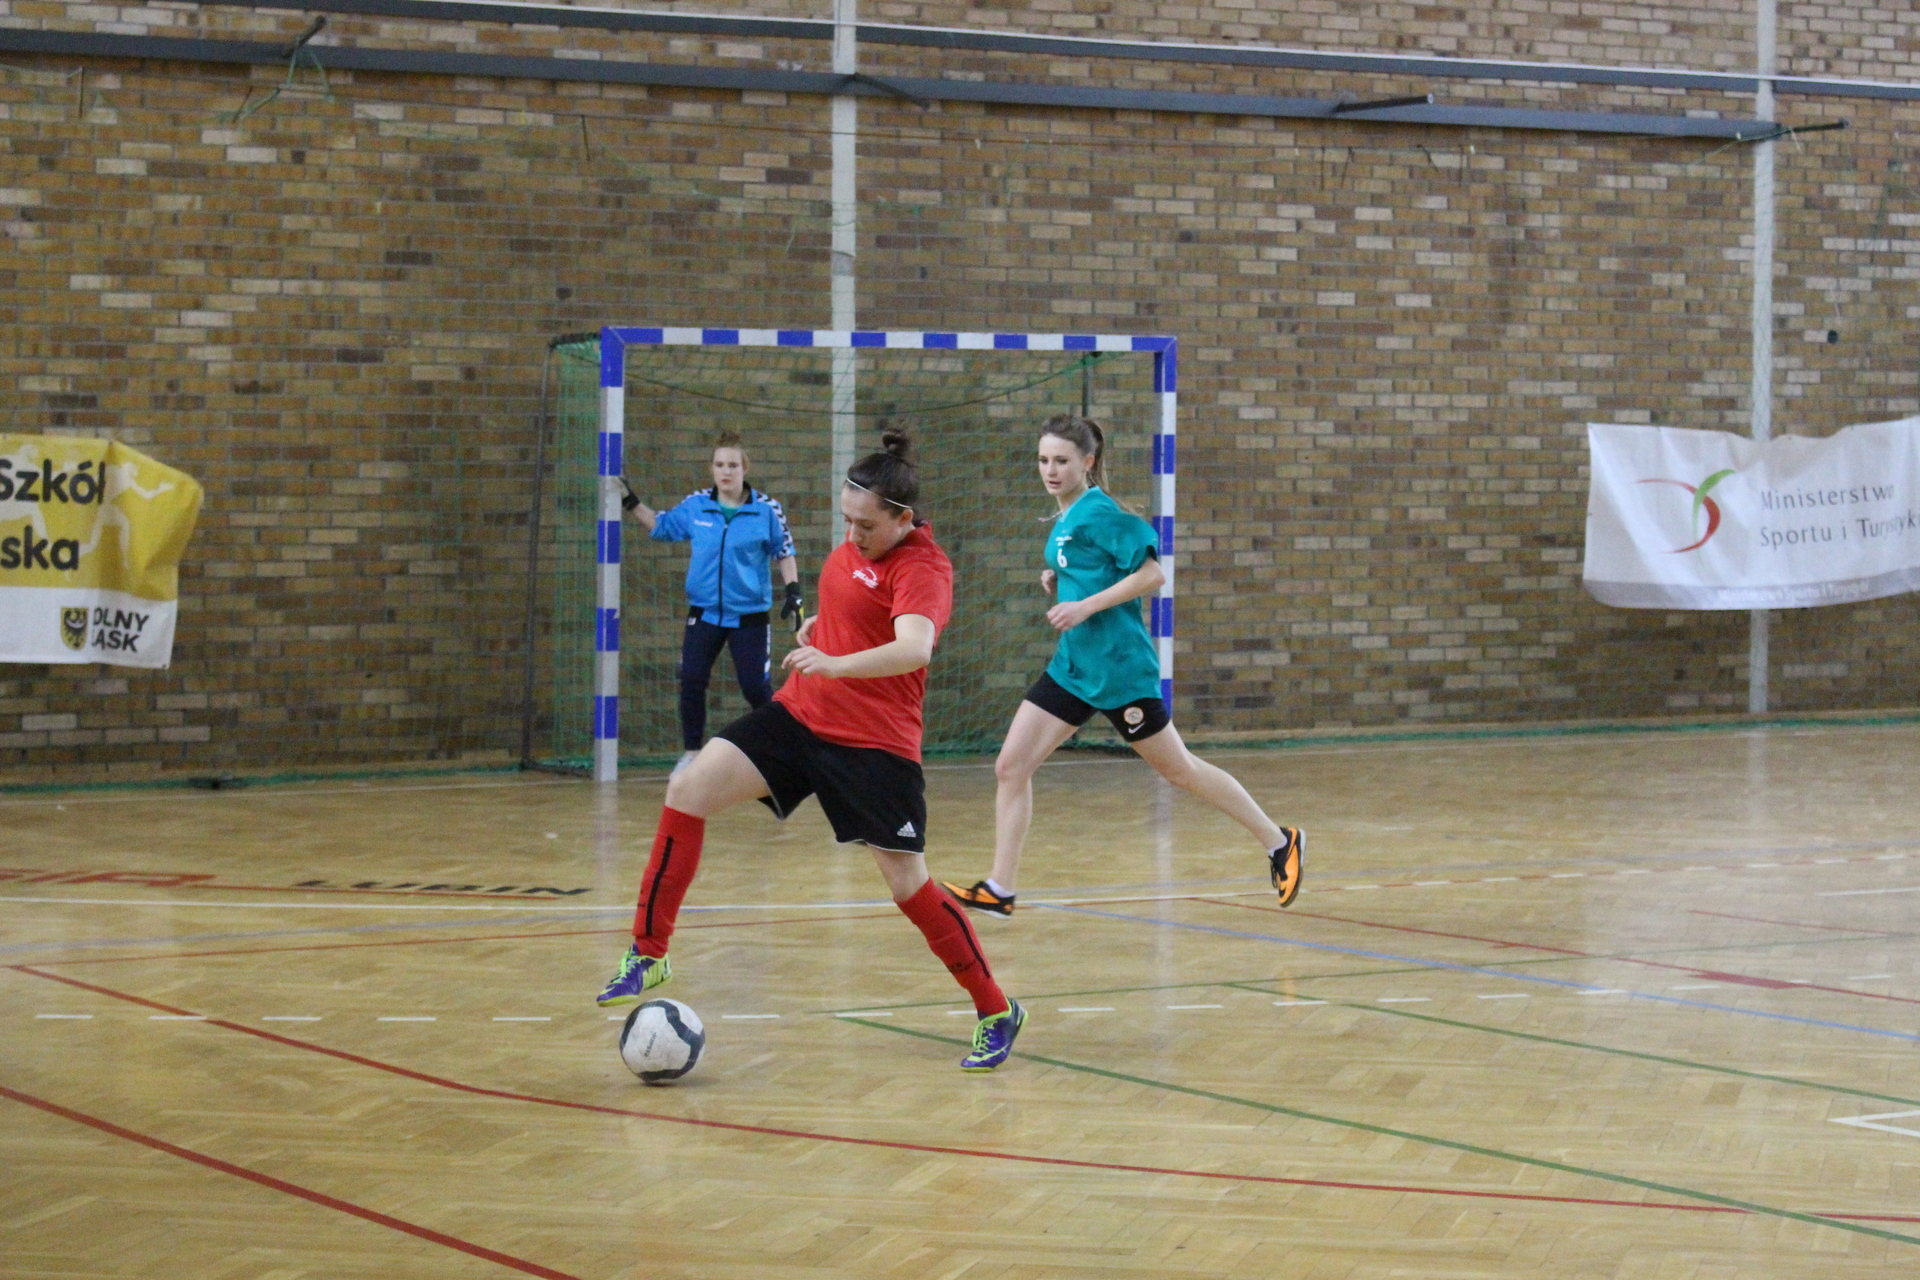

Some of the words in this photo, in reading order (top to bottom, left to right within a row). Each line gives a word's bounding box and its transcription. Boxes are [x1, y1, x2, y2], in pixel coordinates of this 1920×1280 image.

[0, 525, 80, 571] ska
[1760, 524, 1832, 550] Sportu
[1840, 519, 1847, 540] i
[1855, 507, 1920, 541] Turystyk
[1057, 548, 1068, 568] 6
